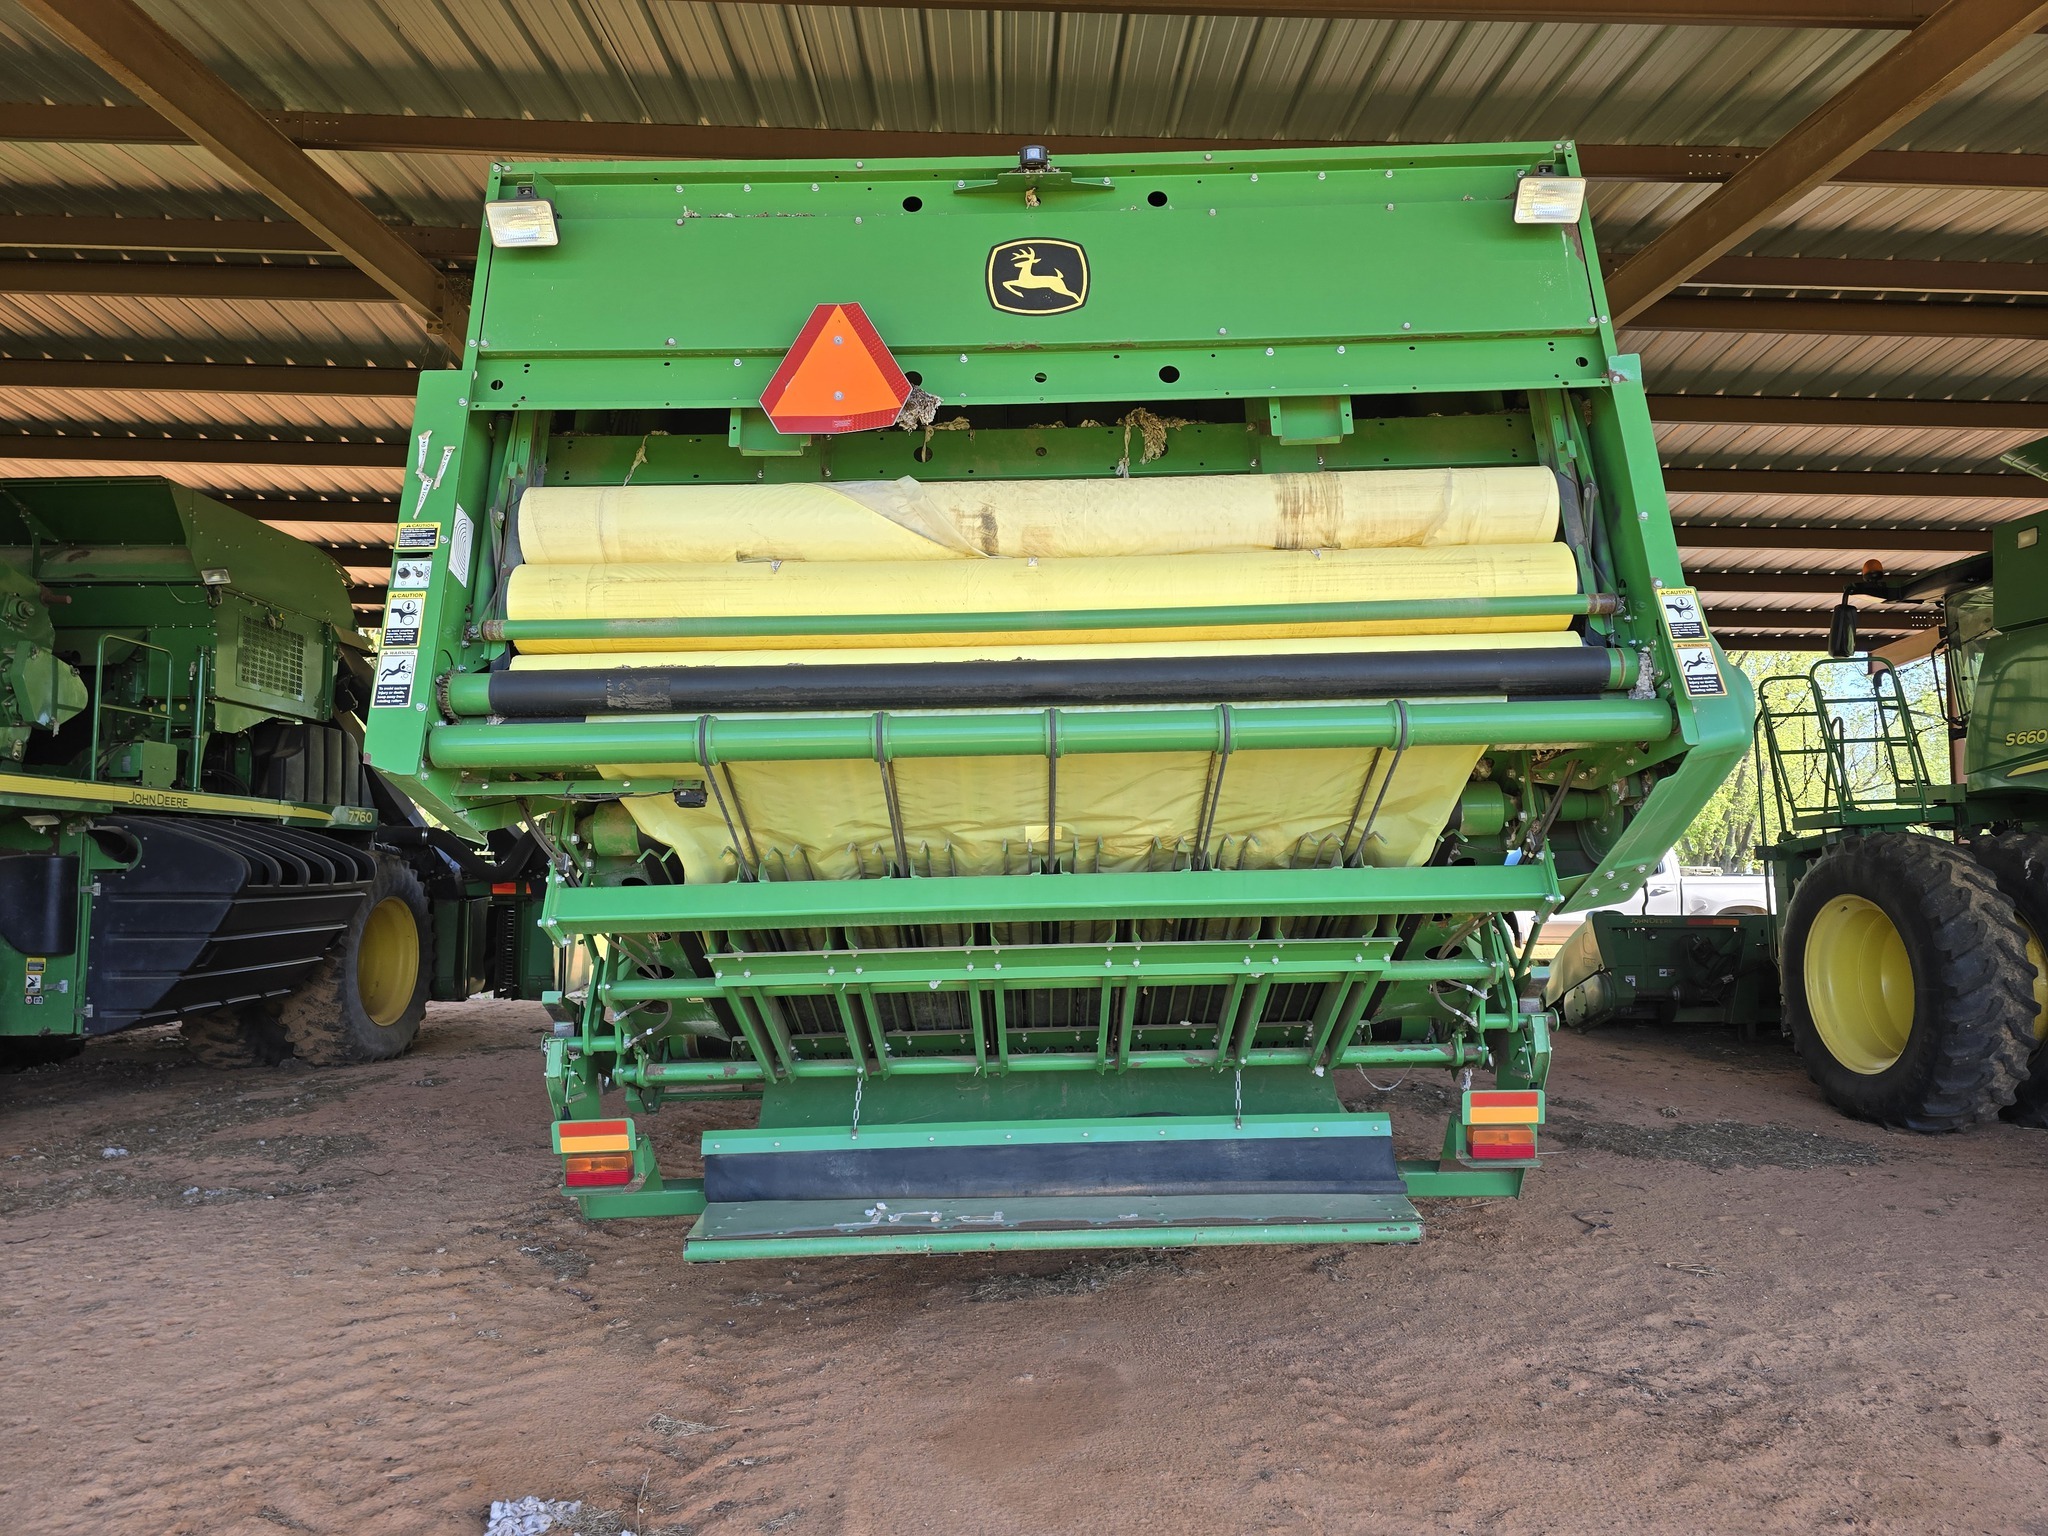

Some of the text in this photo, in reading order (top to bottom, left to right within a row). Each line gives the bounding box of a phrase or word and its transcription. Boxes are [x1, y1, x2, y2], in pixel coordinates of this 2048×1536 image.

[2005, 729, 2048, 746] S660
[128, 791, 188, 807] JOHN DEERE
[348, 810, 373, 823] 7760
